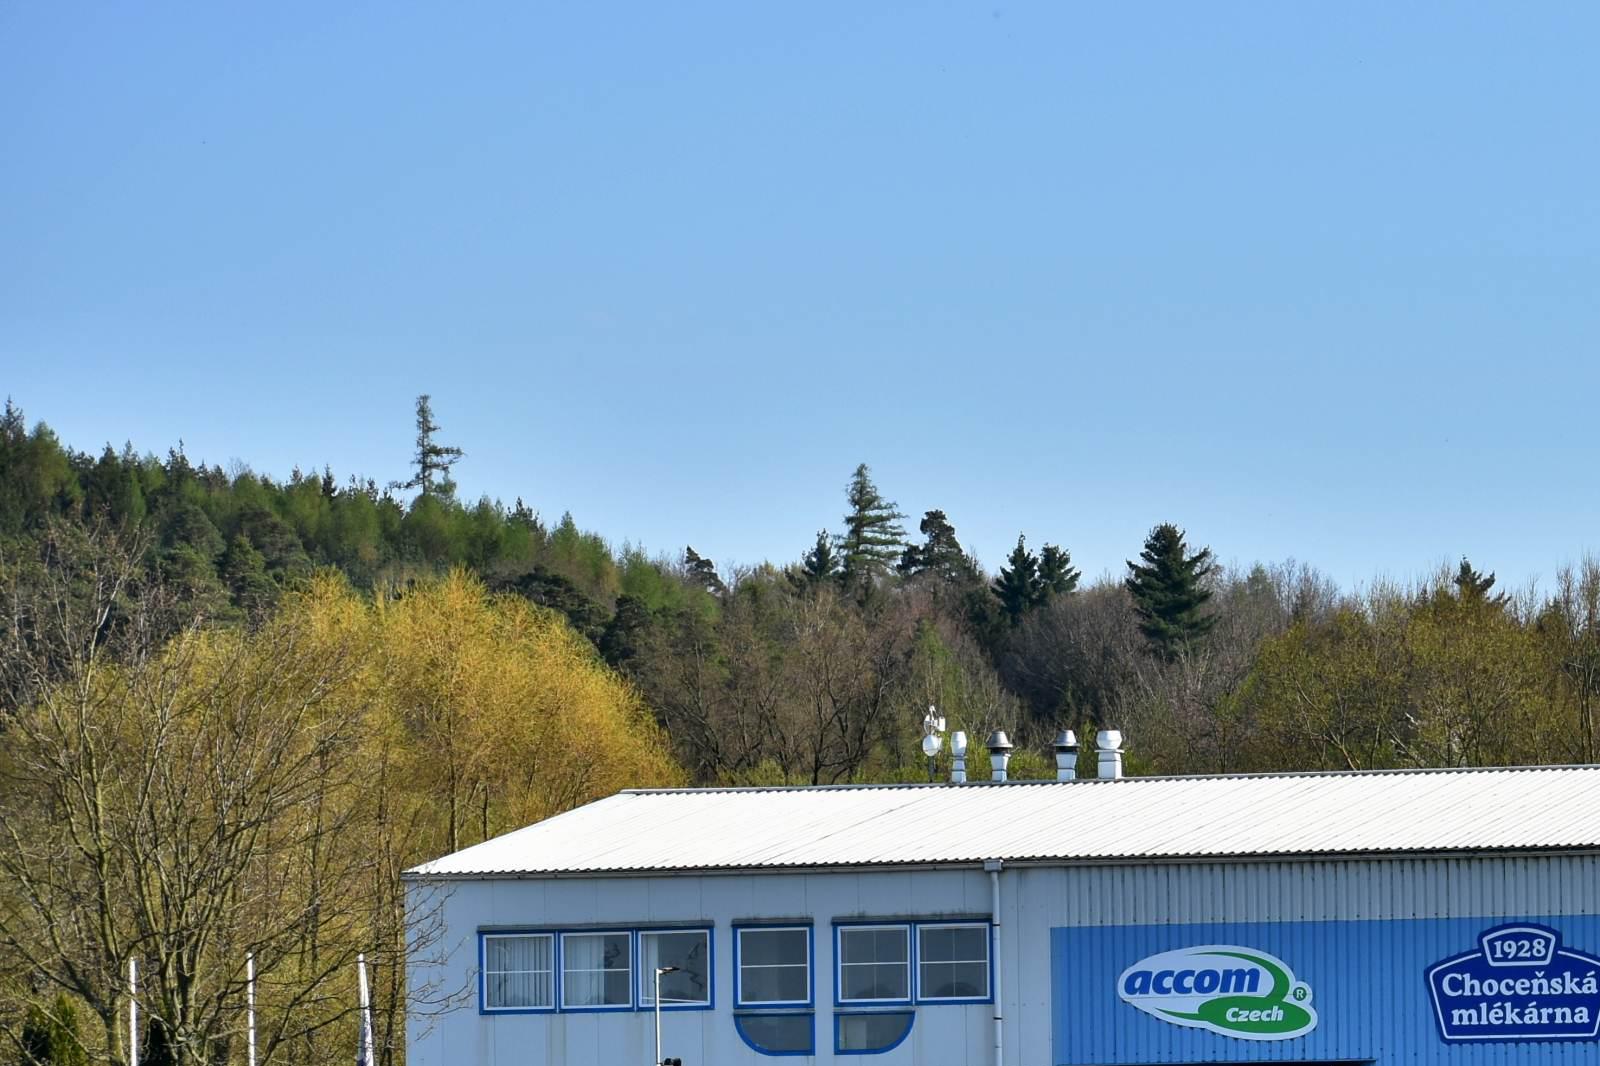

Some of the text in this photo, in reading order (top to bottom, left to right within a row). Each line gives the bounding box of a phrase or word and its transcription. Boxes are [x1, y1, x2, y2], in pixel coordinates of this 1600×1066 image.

[1493, 938, 1546, 959] 1928
[1124, 967, 1260, 995] accom
[1441, 970, 1599, 997] Choceňská
[1225, 1005, 1284, 1022] Czech
[1451, 1001, 1590, 1025] mlékárna
